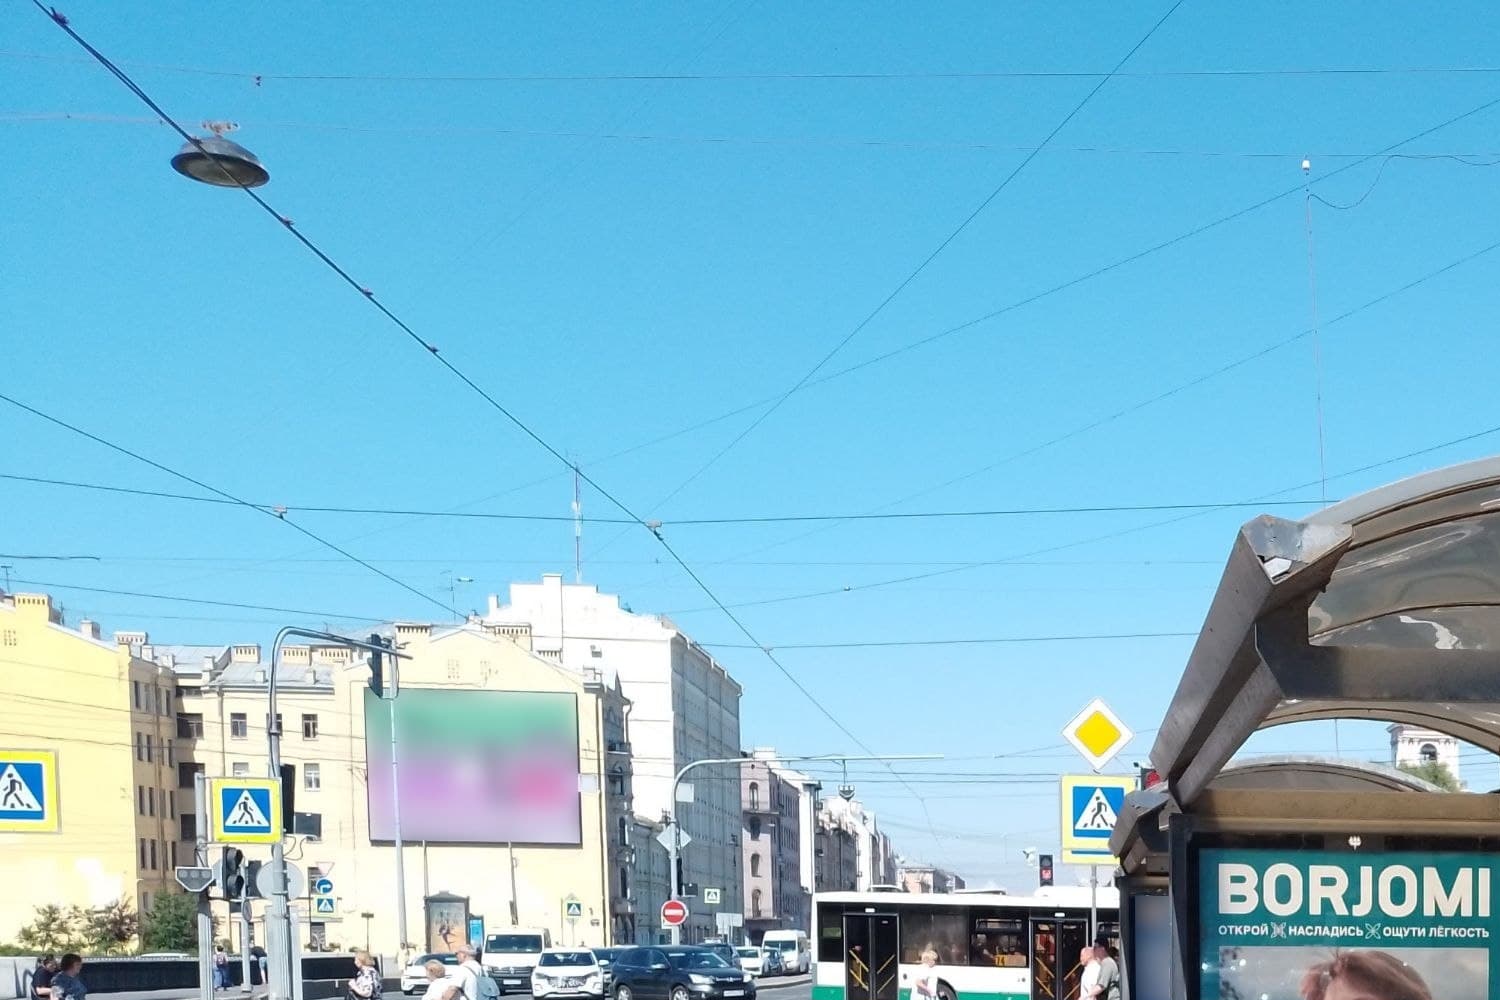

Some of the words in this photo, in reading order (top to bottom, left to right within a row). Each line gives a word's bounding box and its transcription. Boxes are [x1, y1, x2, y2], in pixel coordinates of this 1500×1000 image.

[1218, 863, 1491, 918] BORJOMI
[1218, 923, 1269, 936] ОТКРОЙ
[1288, 925, 1364, 938] НАСЛАДИСЬ
[1383, 926, 1426, 938] ОЩУТИ
[1428, 926, 1490, 939] ЛЁГКОСТЬ
